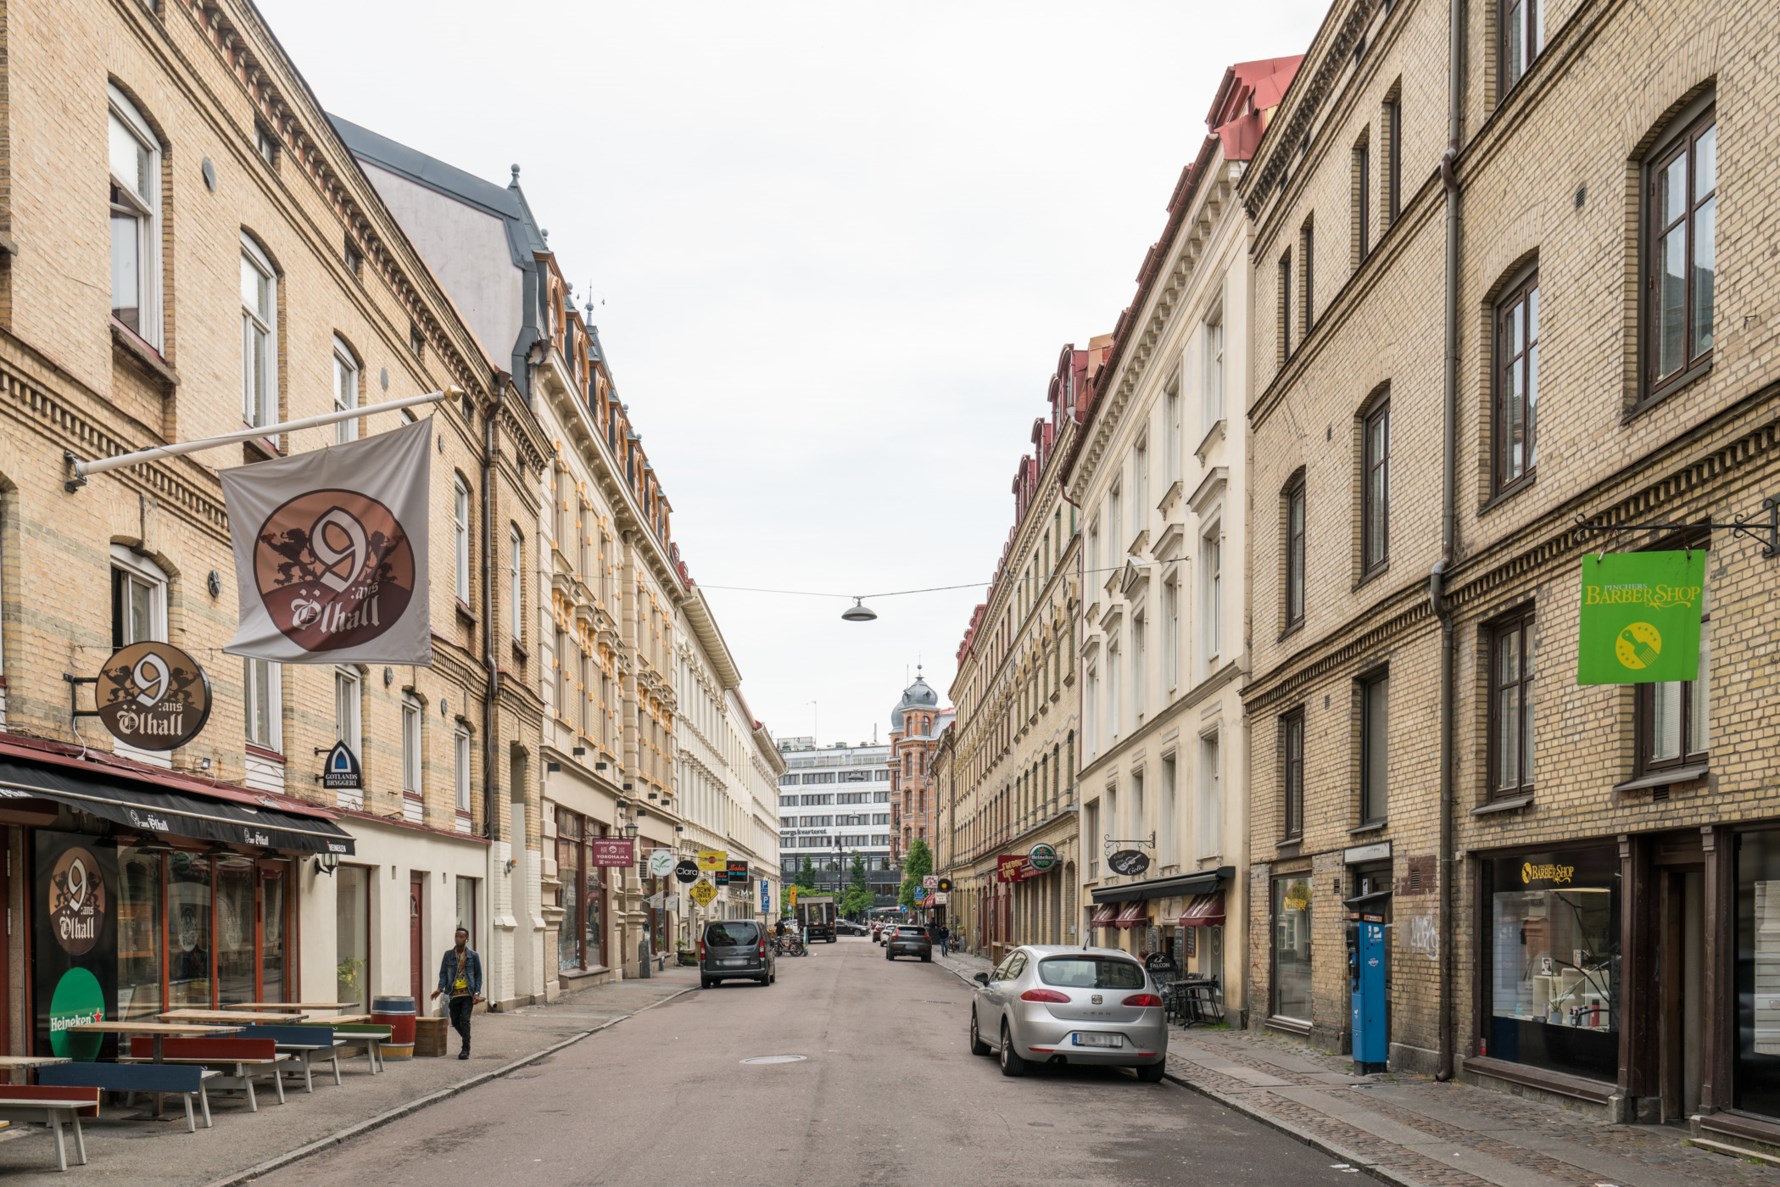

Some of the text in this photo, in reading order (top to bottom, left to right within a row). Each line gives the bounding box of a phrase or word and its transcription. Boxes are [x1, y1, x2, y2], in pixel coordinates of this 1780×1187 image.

[291, 589, 381, 634] Ölhall
[117, 704, 183, 736] Ölhall
[676, 867, 698, 876] Clara
[59, 909, 95, 940] Ölhall
[51, 1014, 93, 1032] Heineken
